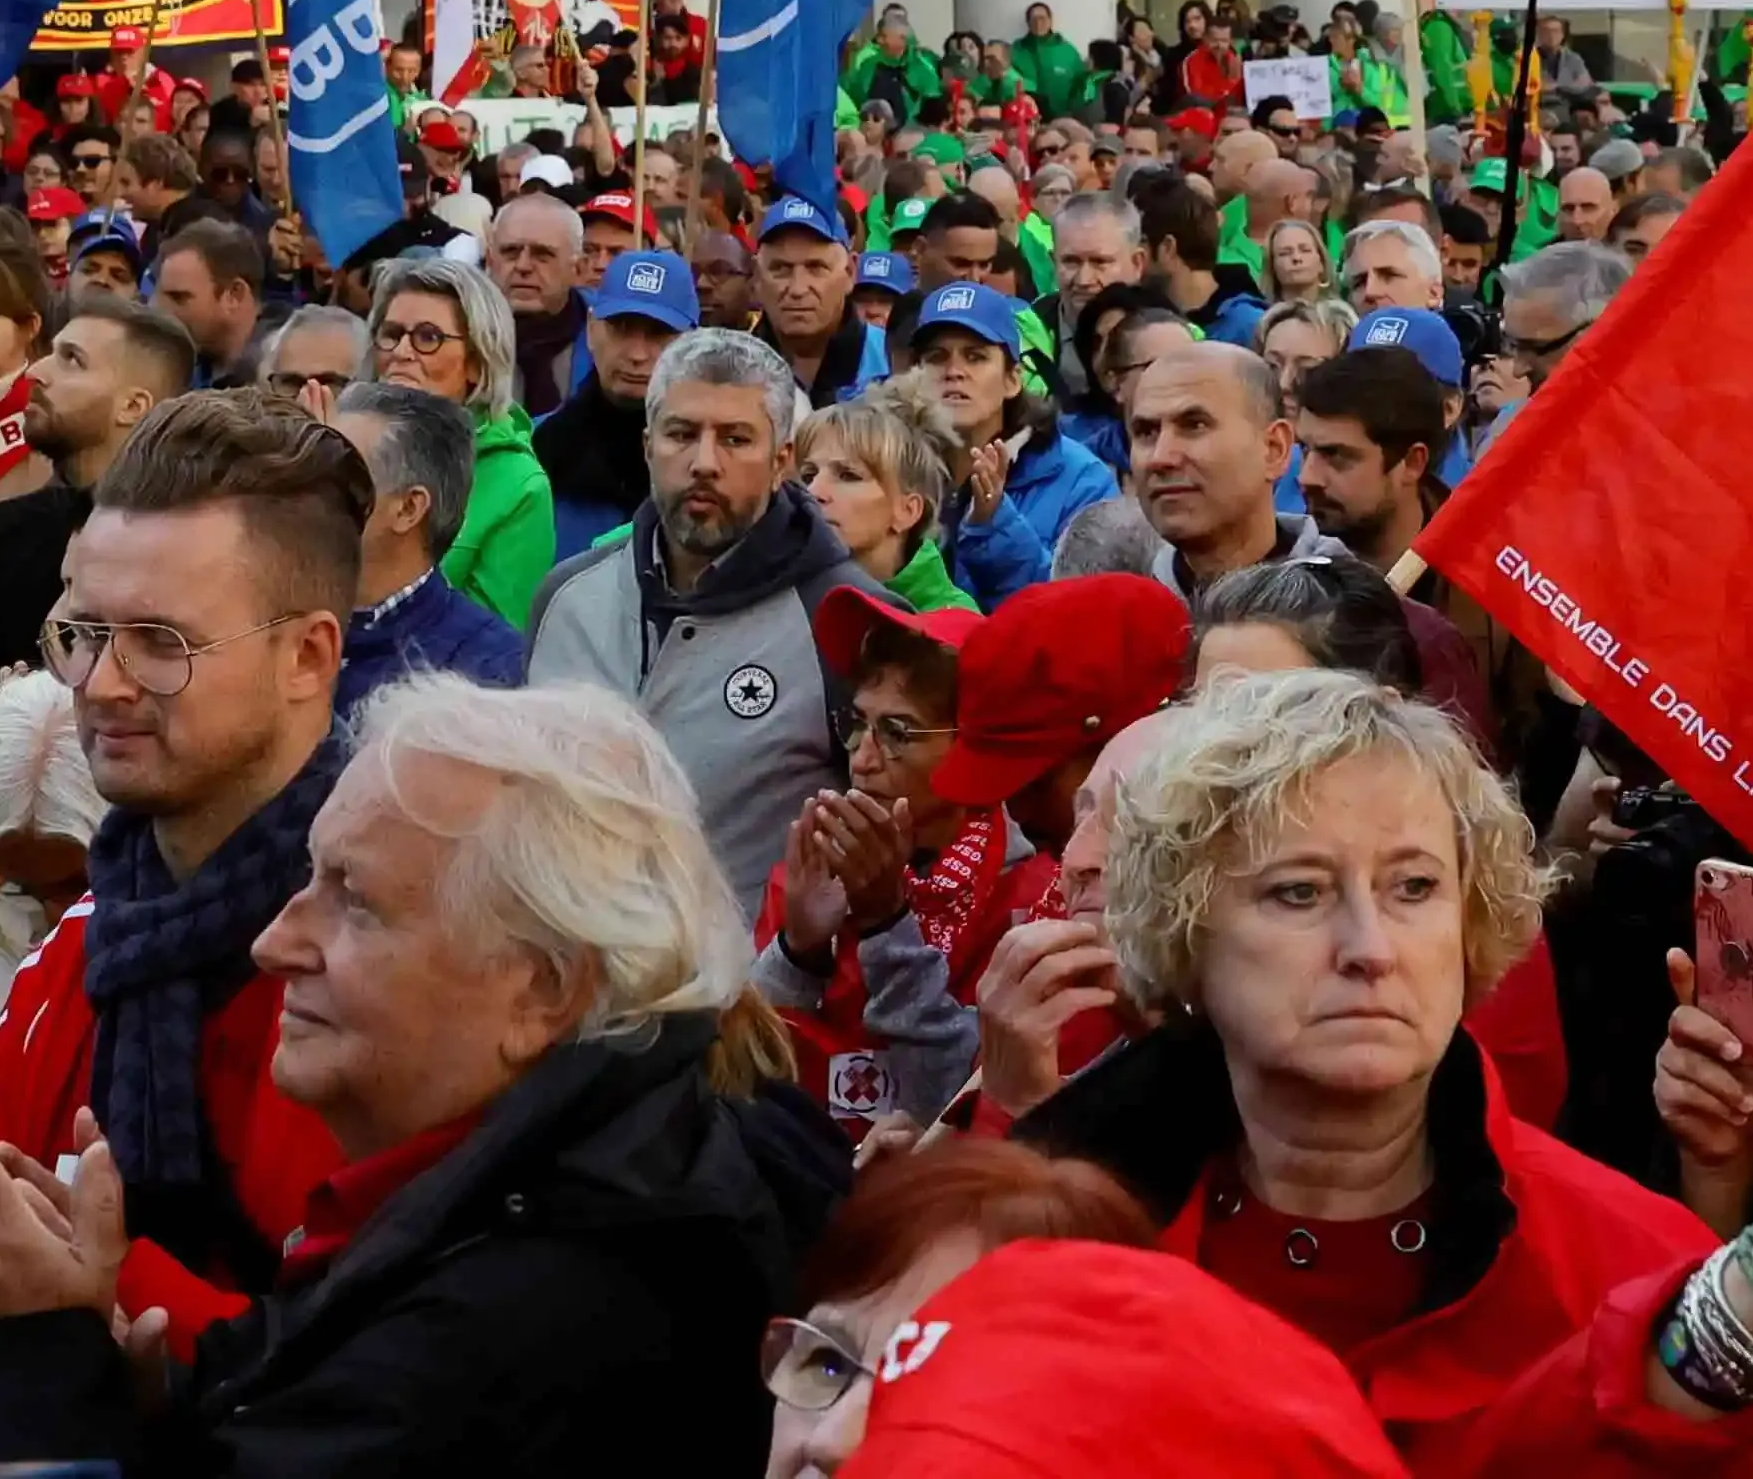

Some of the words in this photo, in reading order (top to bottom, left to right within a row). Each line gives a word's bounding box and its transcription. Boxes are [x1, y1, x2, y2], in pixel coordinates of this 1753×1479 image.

[42, 9, 93, 28] VOOR
[1494, 545, 1651, 690] ENSEMBLE
[1649, 681, 1734, 763] DANS
